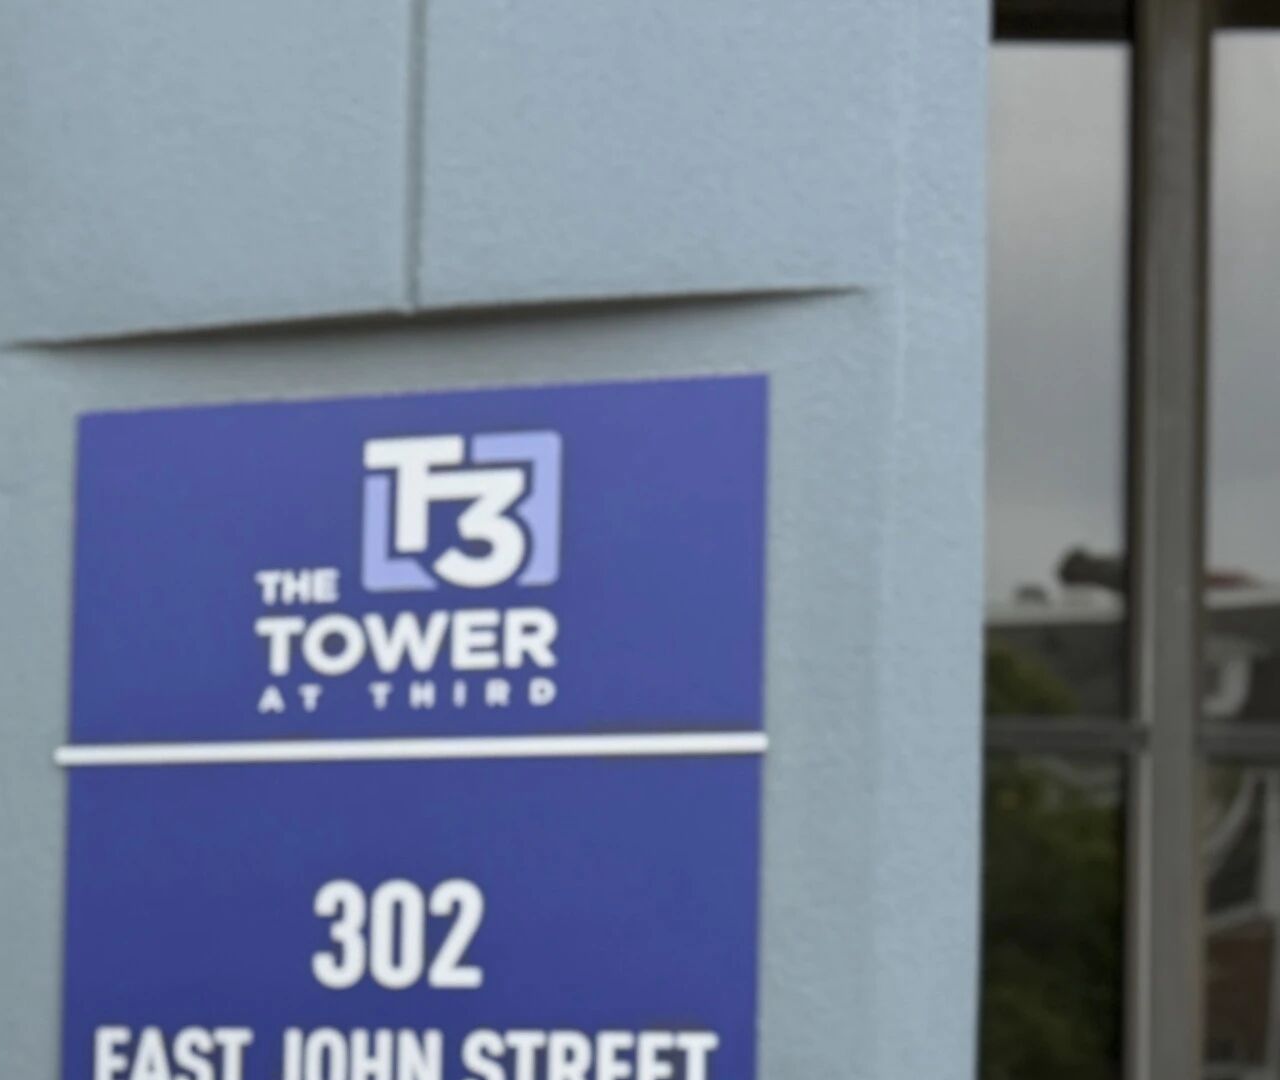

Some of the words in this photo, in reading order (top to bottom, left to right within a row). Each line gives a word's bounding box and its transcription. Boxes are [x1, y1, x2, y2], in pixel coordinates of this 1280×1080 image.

[255, 567, 339, 604] THE
[254, 607, 558, 676] TOWER
[257, 683, 323, 713] AT
[369, 679, 557, 709] THIRD
[311, 878, 485, 990] 302
